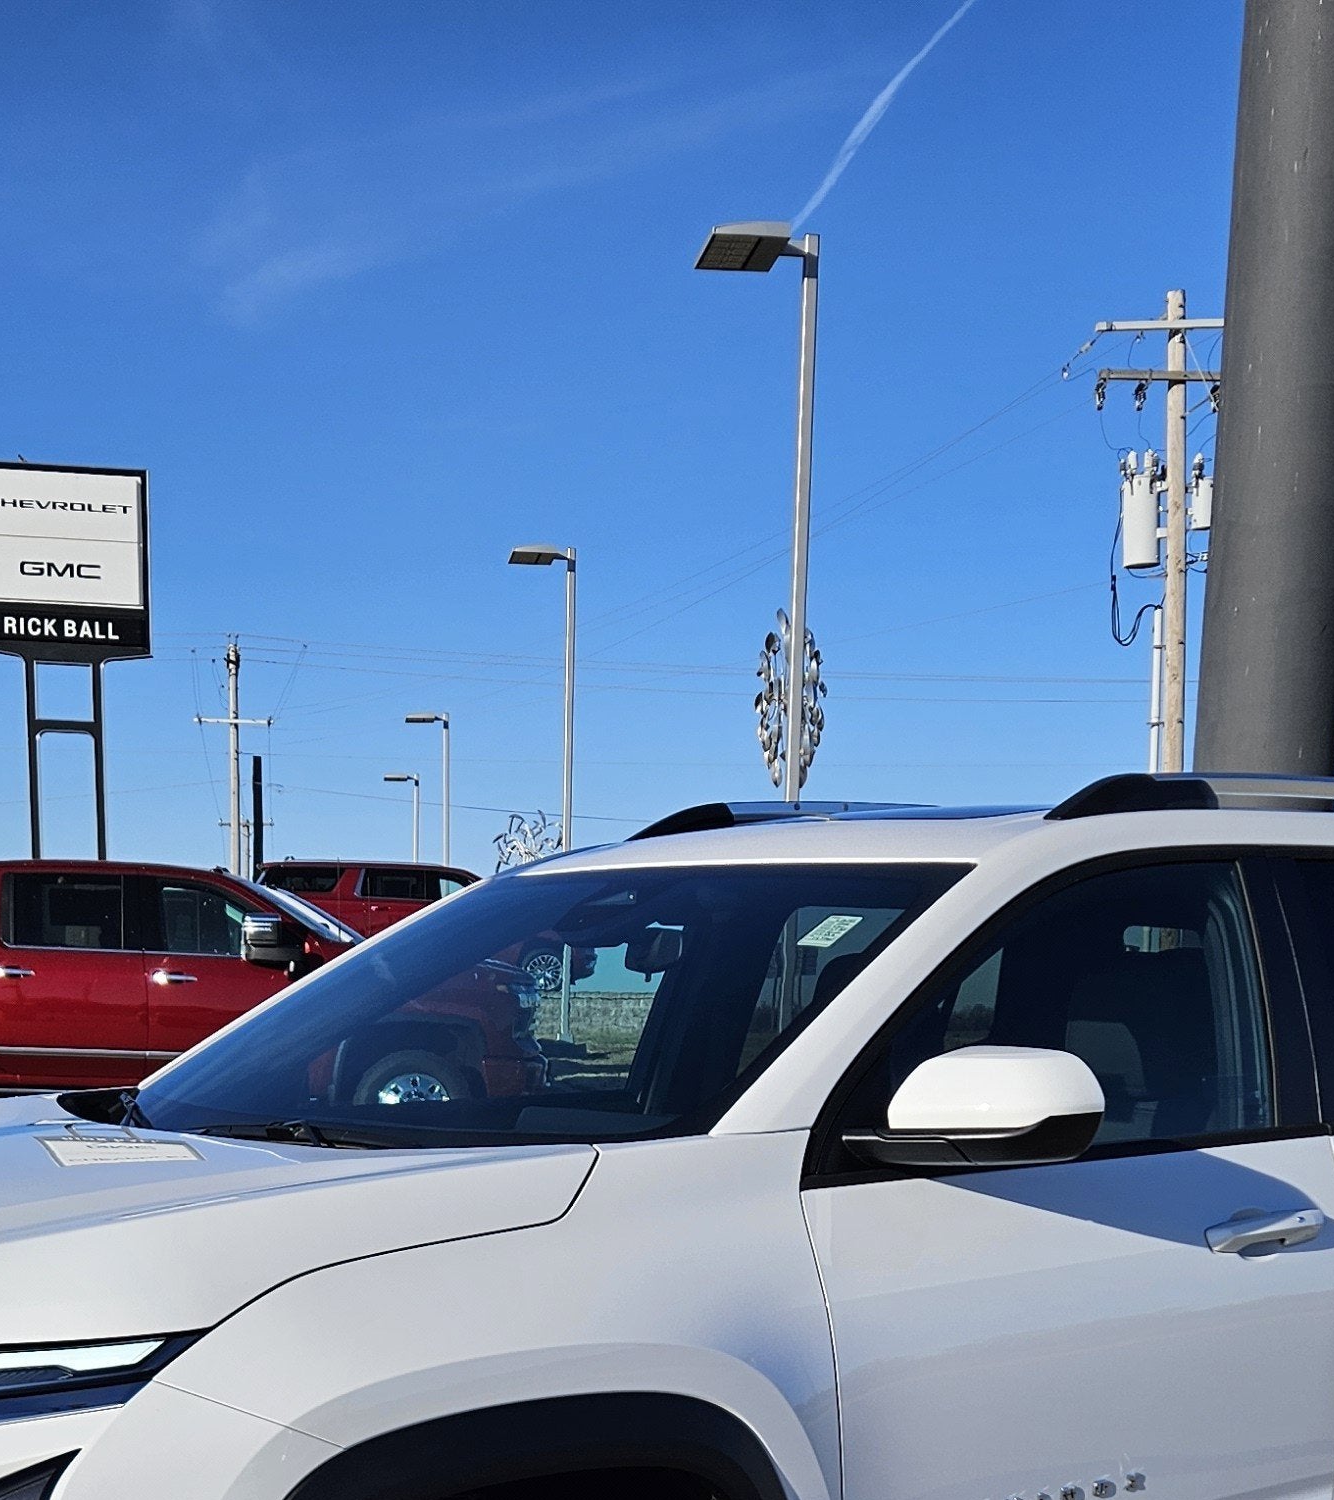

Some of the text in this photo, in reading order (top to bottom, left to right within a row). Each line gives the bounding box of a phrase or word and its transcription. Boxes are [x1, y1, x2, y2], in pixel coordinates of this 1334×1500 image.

[19, 560, 101, 580] GMC
[4, 616, 120, 640] RICK BALL
